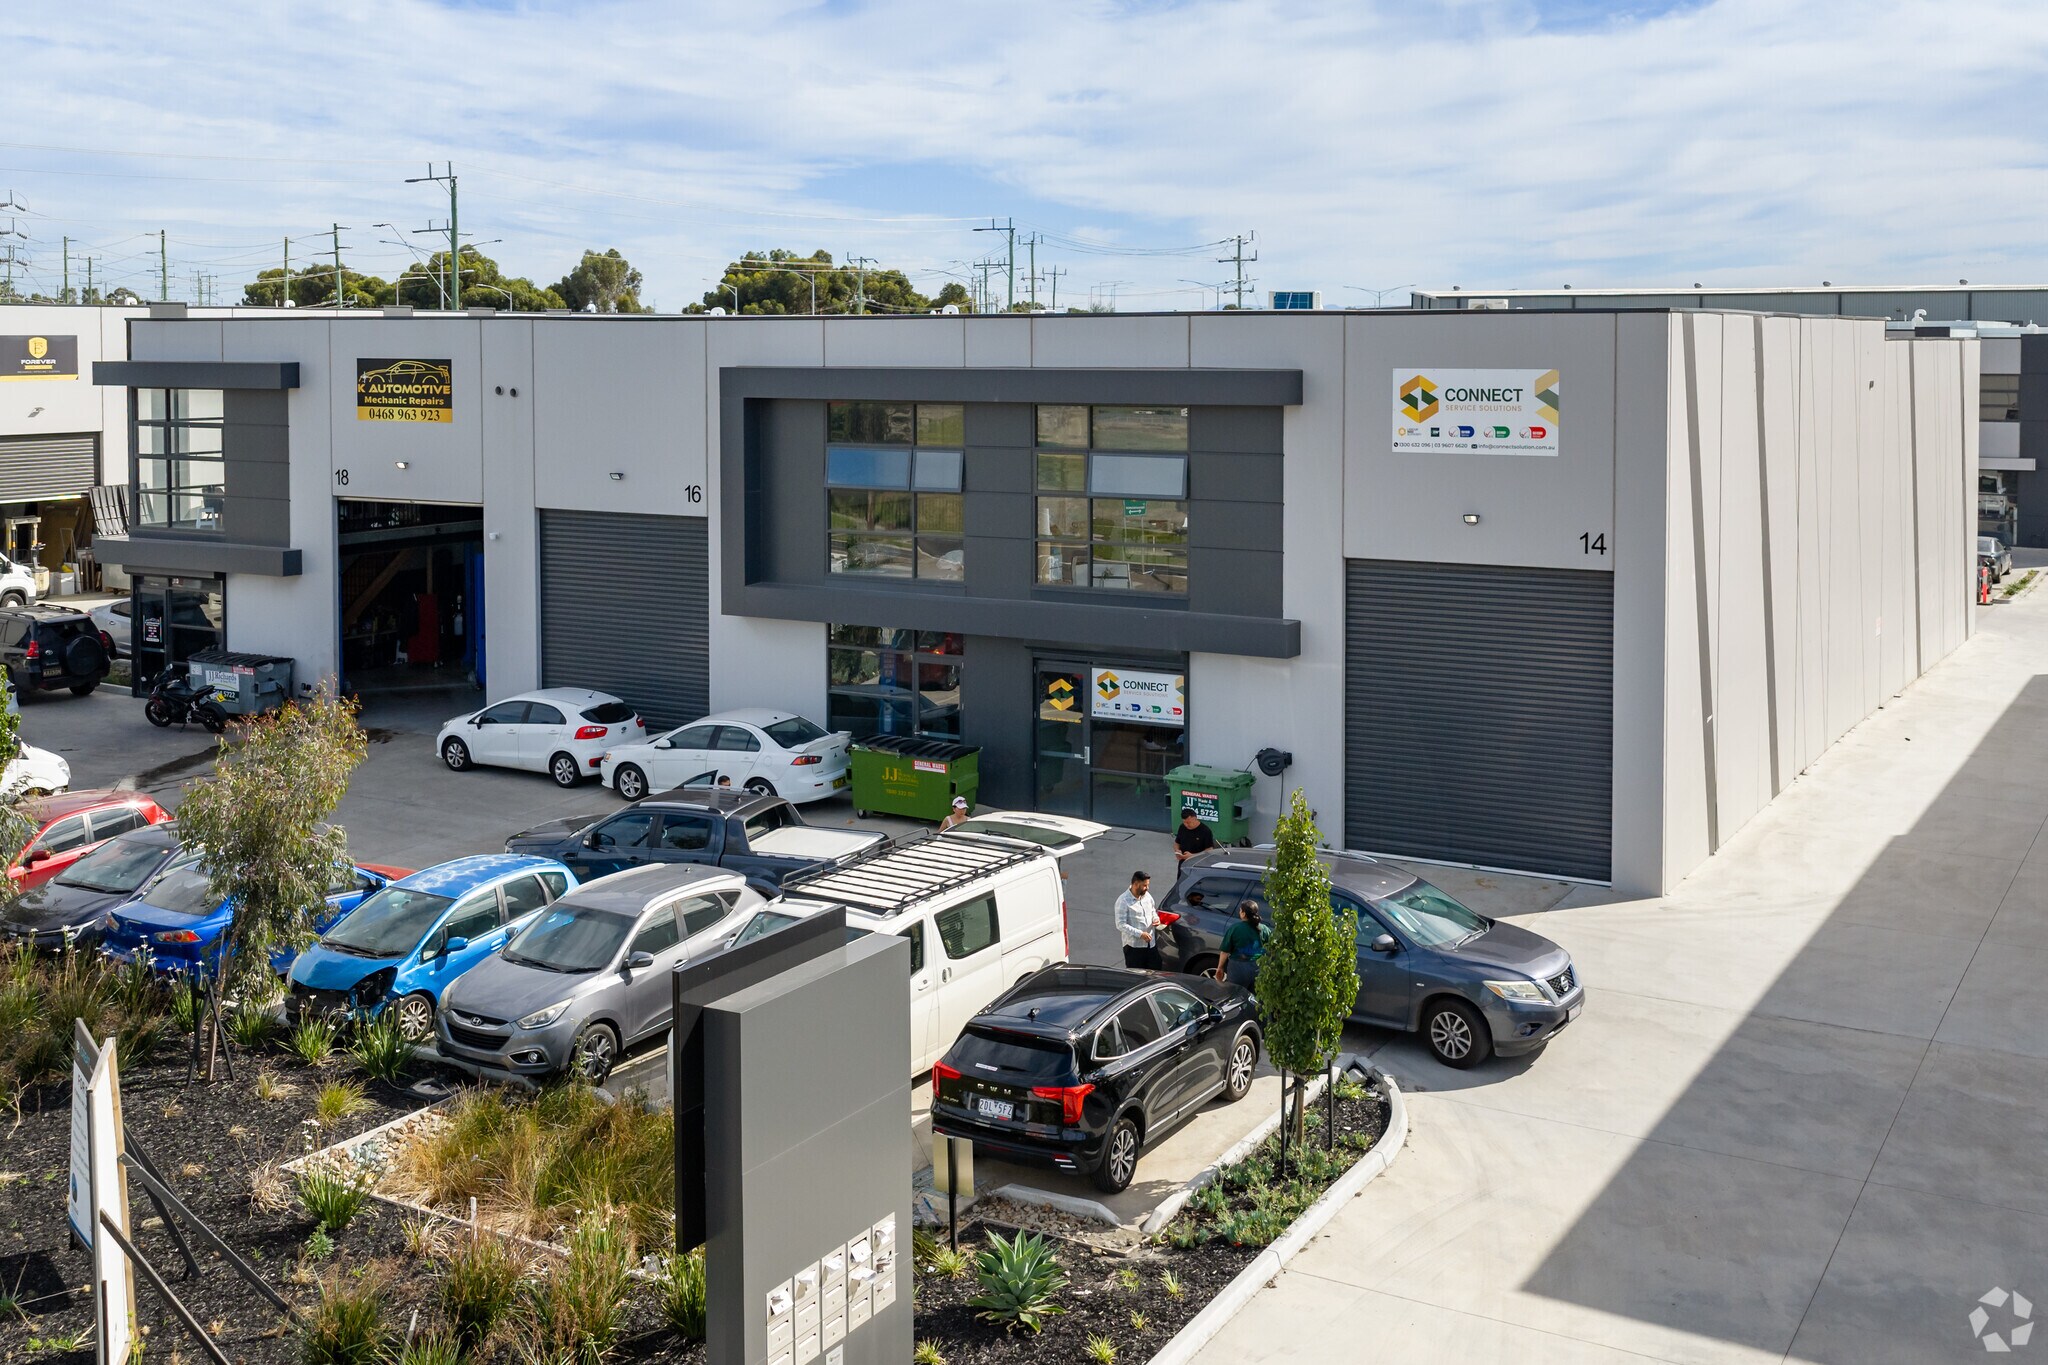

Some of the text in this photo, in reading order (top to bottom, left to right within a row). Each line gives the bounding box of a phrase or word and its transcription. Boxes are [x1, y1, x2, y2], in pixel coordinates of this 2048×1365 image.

[357, 384, 451, 394] K AUTOMOTIVE
[1445, 388, 1524, 402] CONNECT
[364, 396, 445, 407] Mechanic Repairs
[369, 408, 440, 421] 0468 963 923
[335, 469, 349, 486] 18
[685, 485, 702, 503] 16
[1580, 532, 1607, 555] 14
[1123, 680, 1169, 692] CONNECT
[224, 690, 236, 699] 5722
[932, 762, 945, 770] WASTE
[1200, 808, 1219, 817] 5722
